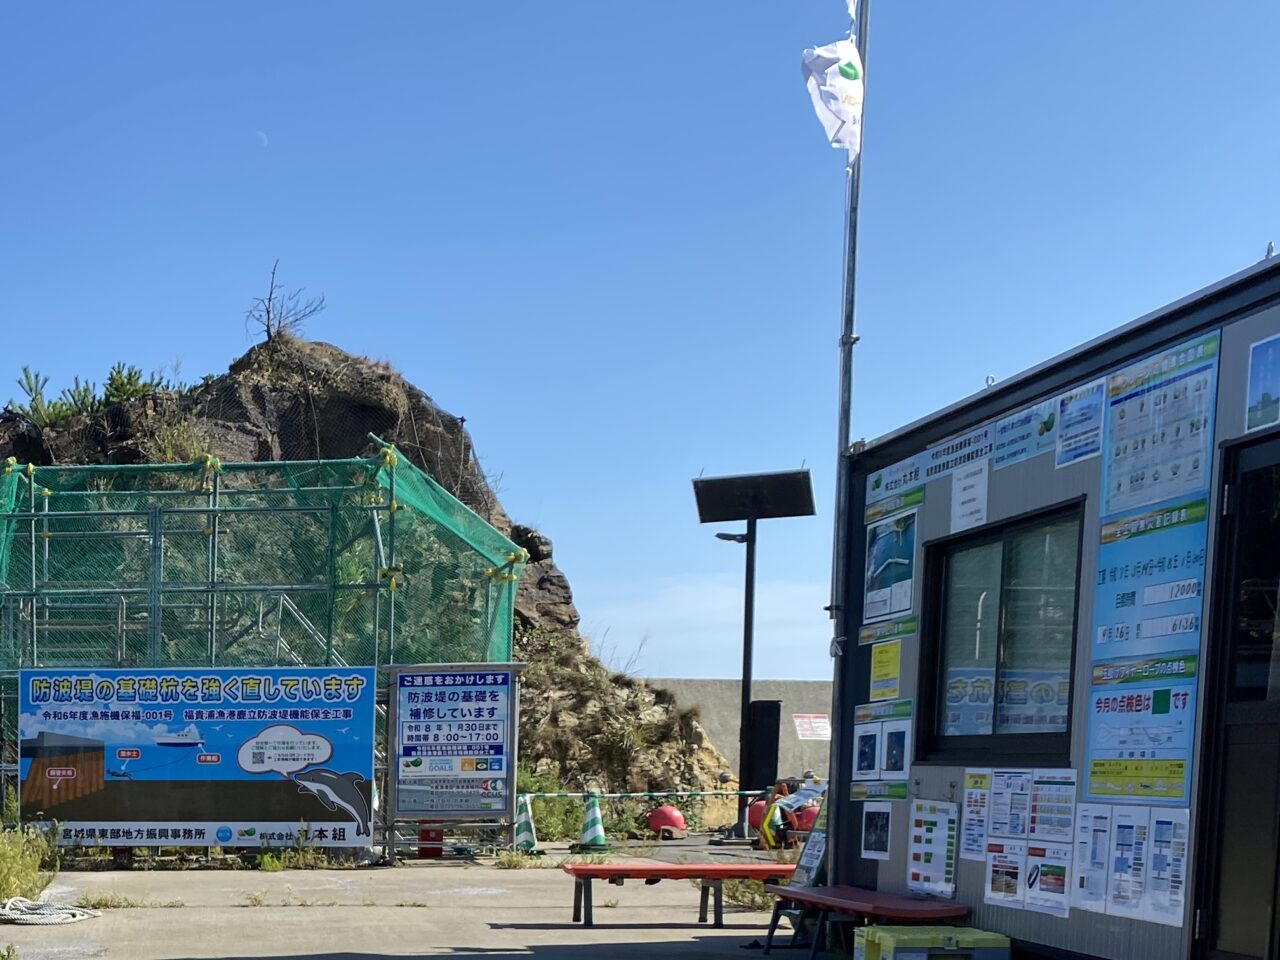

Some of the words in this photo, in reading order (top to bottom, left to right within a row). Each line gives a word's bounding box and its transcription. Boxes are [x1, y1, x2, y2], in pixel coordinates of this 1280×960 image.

[404, 675, 504, 685] ご迷惑をおかけします
[31, 675, 365, 703] 防波堤の基礎杭を強く直しています
[407, 690, 500, 703] 防波堤の基礎を
[409, 707, 498, 720] 補修しています
[62, 828, 206, 840] 宮城県東部地方振興事務所
